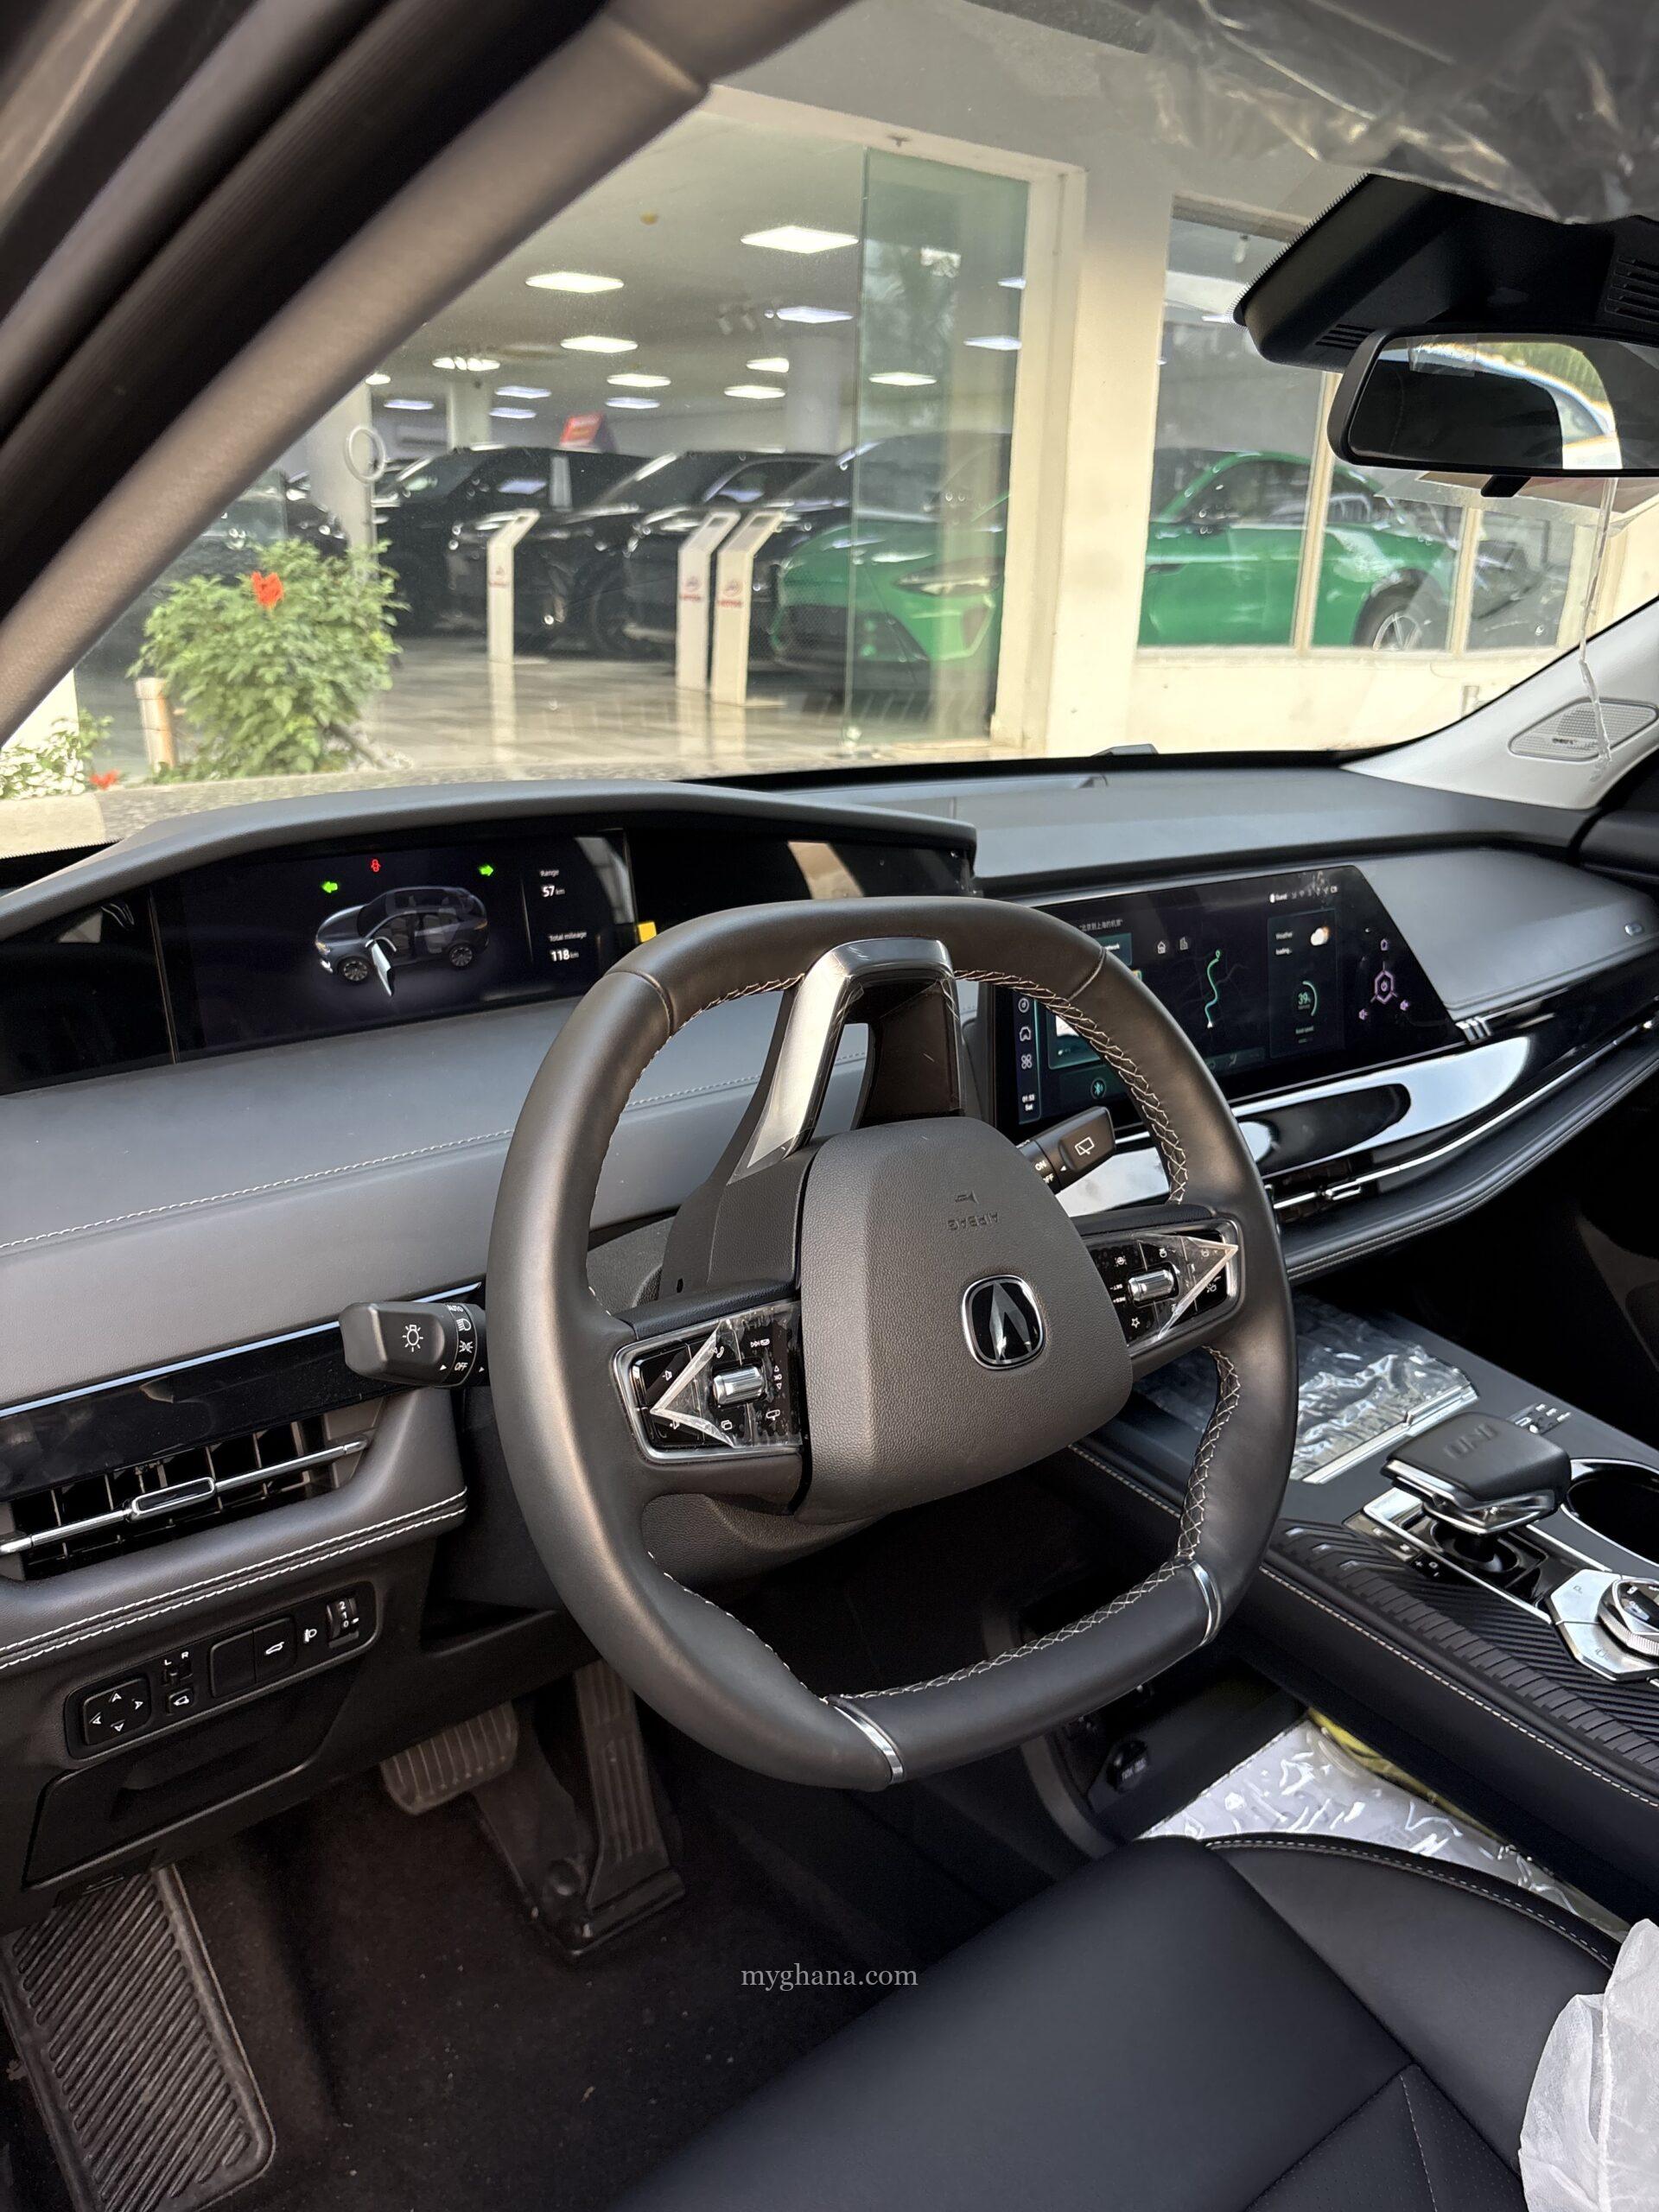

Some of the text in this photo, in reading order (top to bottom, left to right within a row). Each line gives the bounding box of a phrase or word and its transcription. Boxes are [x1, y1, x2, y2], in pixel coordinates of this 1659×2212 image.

[542, 885, 555, 897] 57
[564, 931, 587, 940] mileage
[551, 950, 569, 962] 118
[1034, 1160, 1047, 1171] ON
[447, 1304, 464, 1313] AUTO
[454, 1362, 468, 1372] OFF
[339, 1600, 346, 1611] 2
[341, 1611, 347, 1619] 1
